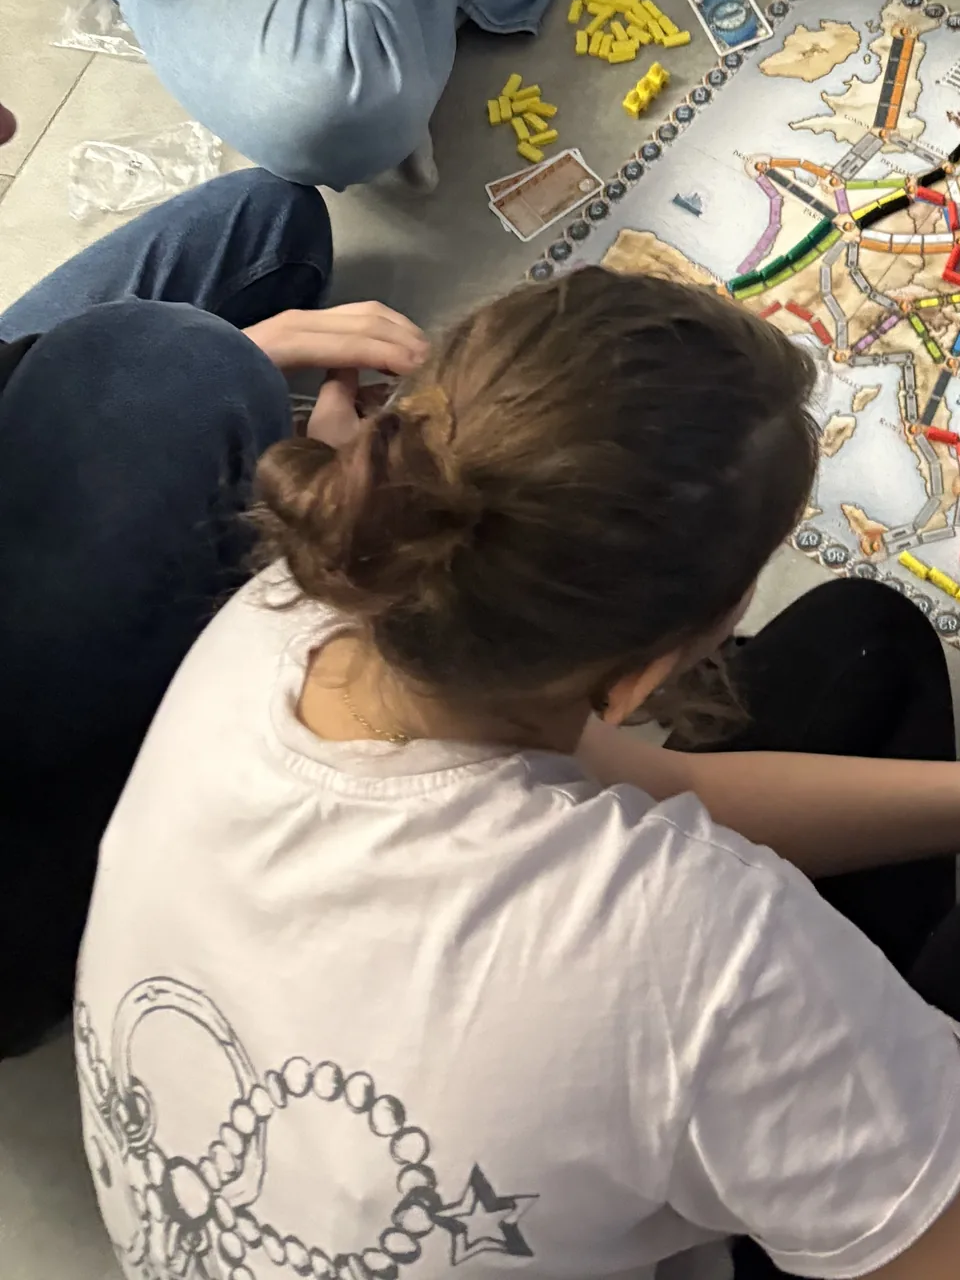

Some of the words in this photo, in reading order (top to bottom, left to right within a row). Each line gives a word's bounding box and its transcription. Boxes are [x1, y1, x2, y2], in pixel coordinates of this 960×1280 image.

[801, 533, 819, 546] 87
[827, 550, 846, 563] 86
[938, 616, 958, 631] 82
